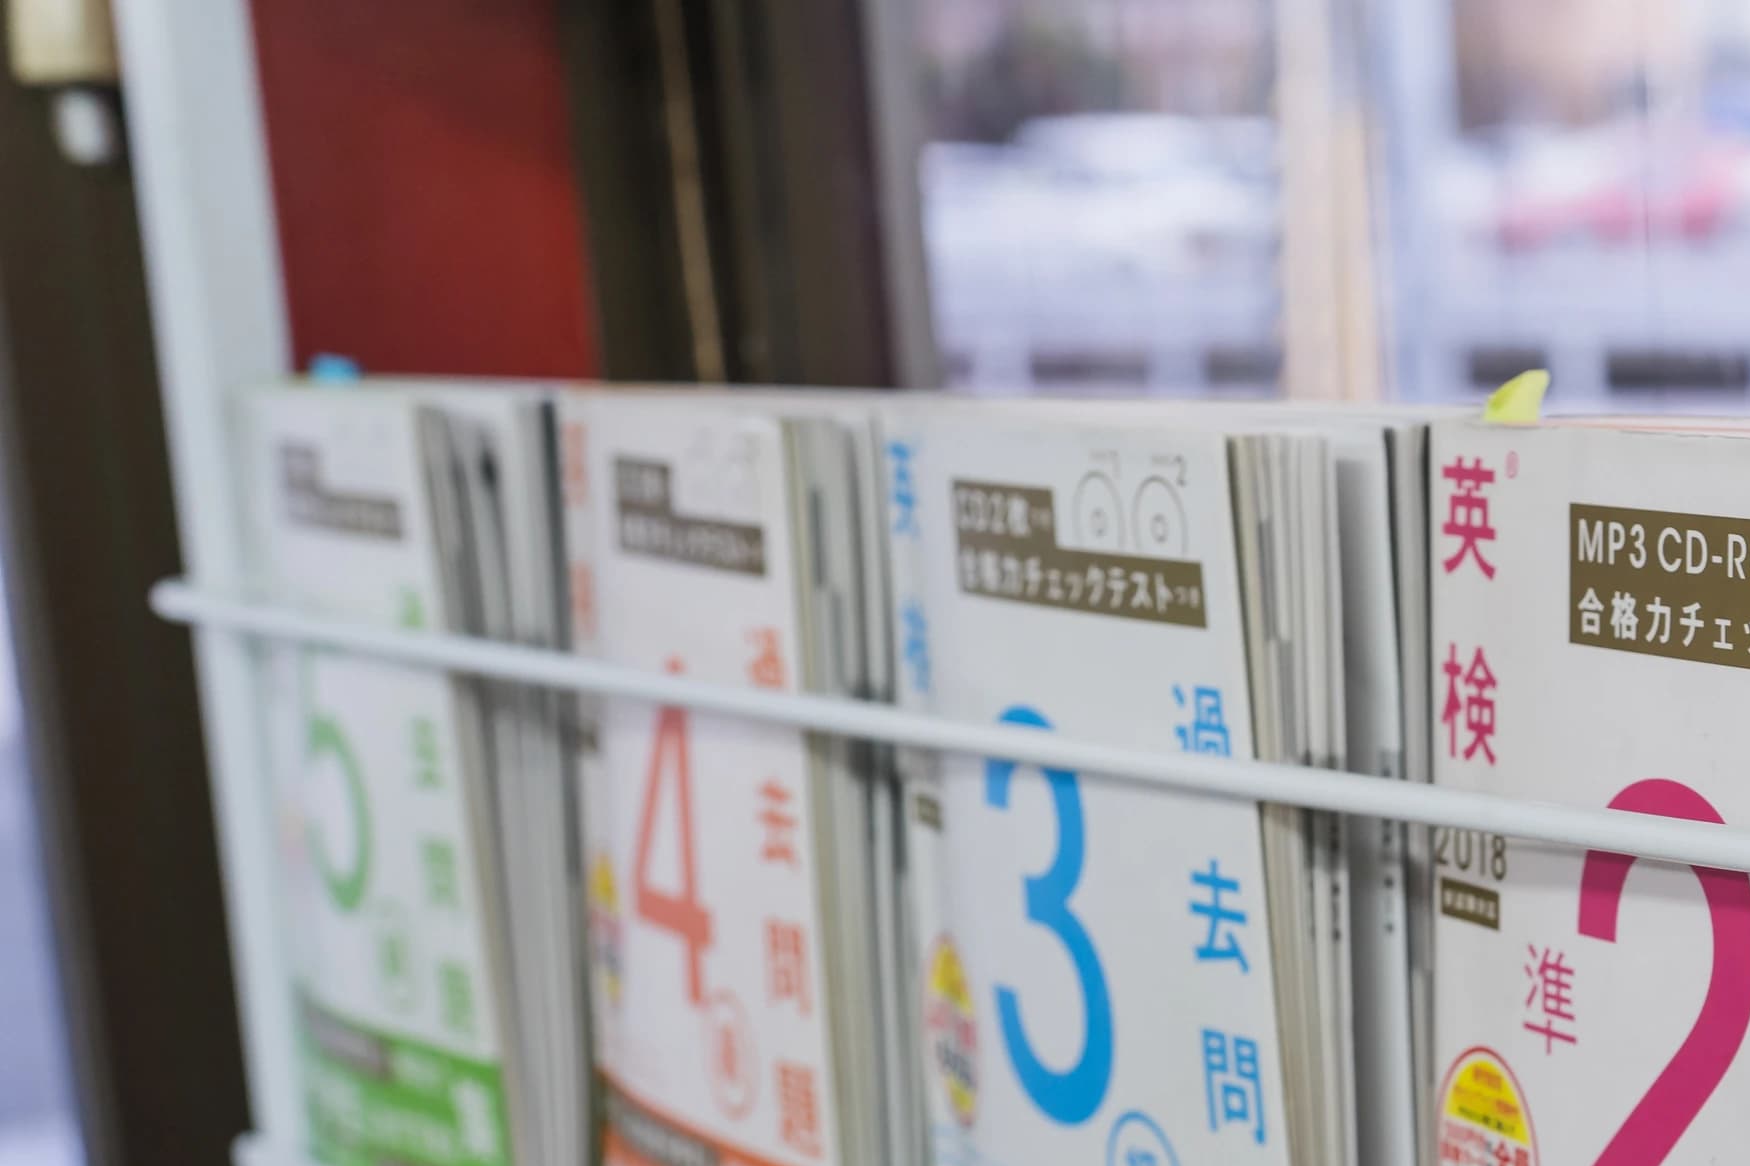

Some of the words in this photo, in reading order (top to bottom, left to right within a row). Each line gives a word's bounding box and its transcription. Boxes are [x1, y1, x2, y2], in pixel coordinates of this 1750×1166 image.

[1442, 457, 1496, 765] 英検
[1578, 518, 1647, 570] MP3
[632, 655, 714, 1009] 4
[981, 704, 1115, 1127] 3
[1523, 943, 1578, 1056] 準
